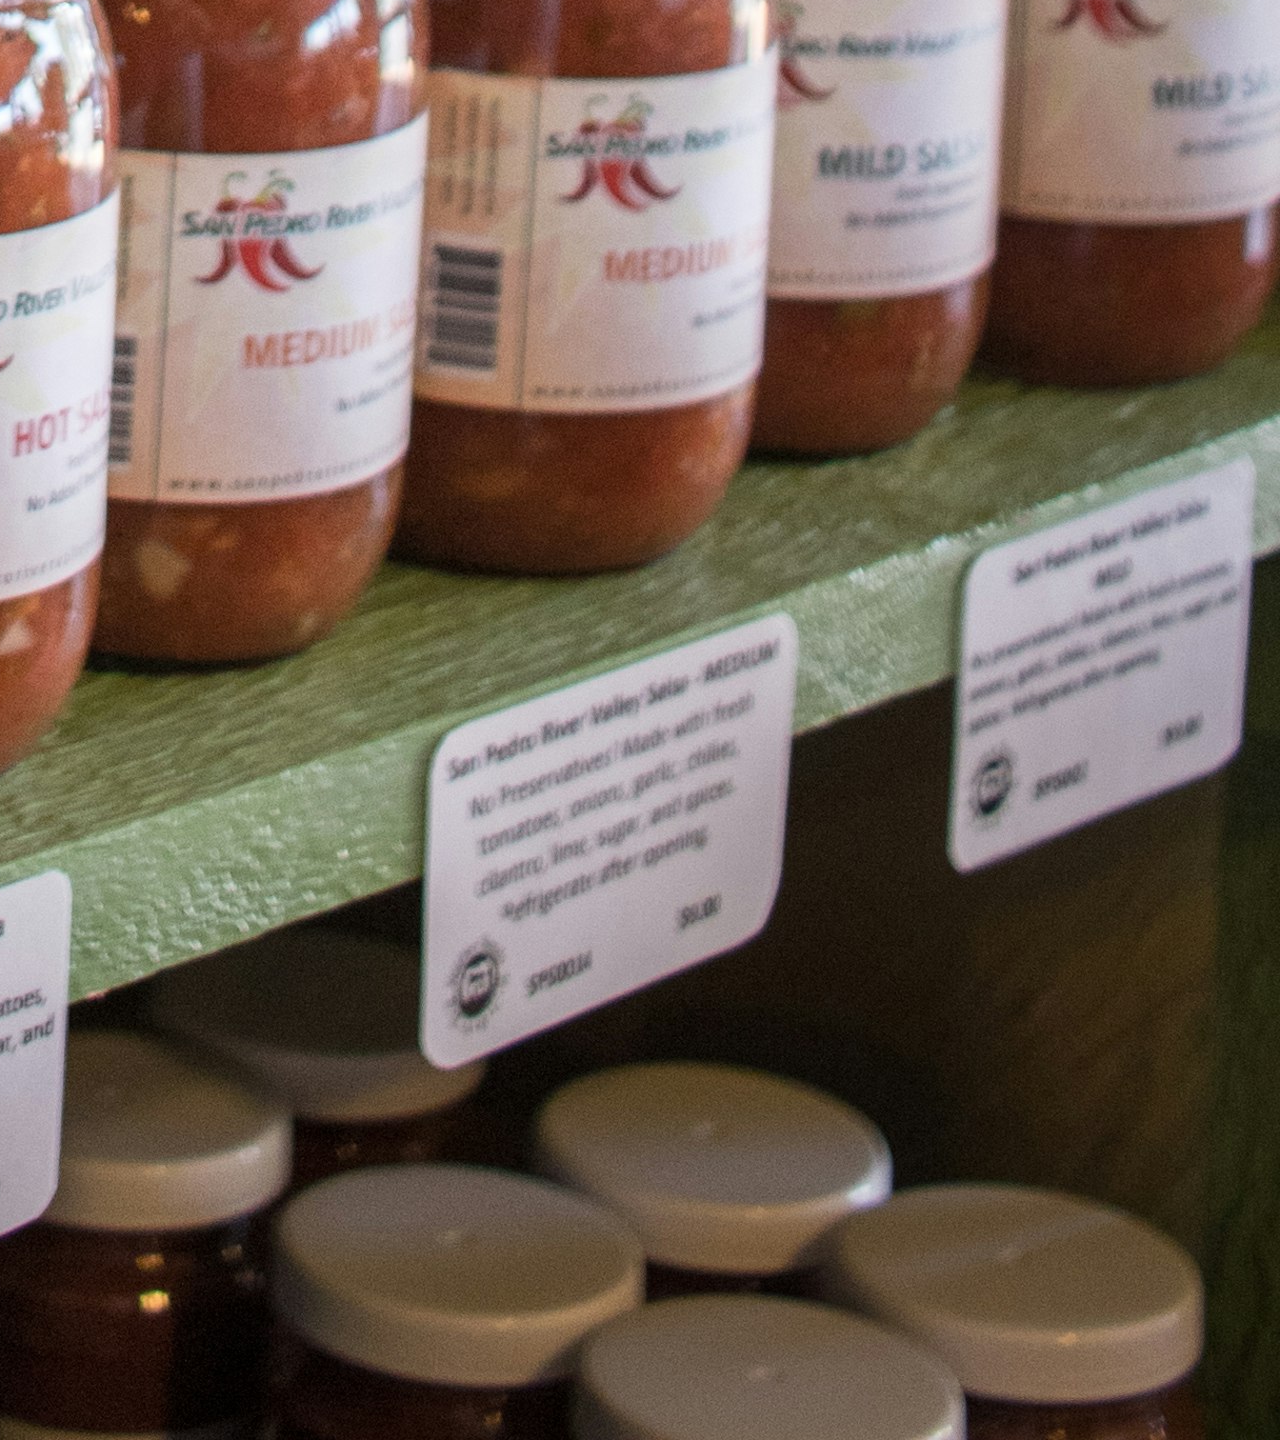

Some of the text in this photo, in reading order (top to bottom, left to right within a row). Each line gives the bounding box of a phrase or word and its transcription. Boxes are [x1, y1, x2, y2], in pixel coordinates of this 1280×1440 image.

[180, 210, 240, 238] SAN
[603, 243, 732, 283] MEDIUM
[12, 289, 65, 319] RIVER
[243, 323, 378, 368] MEDIUM
[11, 406, 70, 458] HOT
[22, 1017, 56, 1048] and
